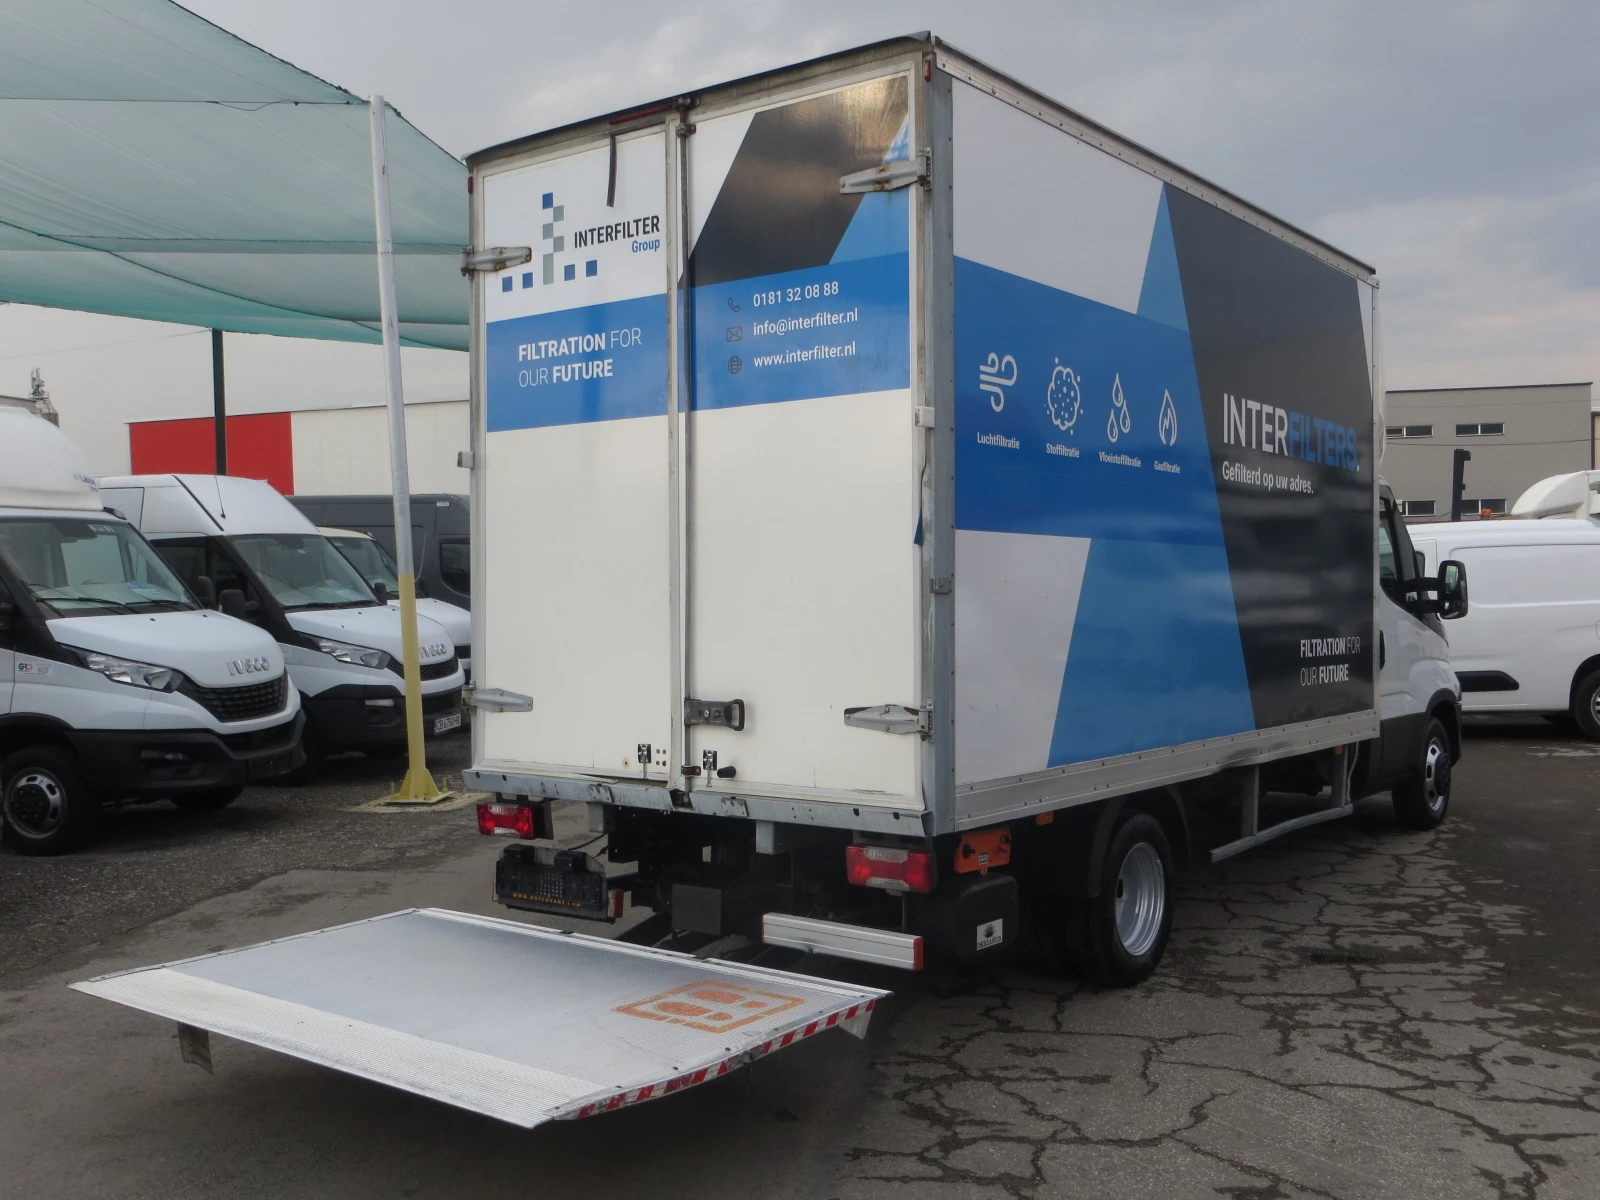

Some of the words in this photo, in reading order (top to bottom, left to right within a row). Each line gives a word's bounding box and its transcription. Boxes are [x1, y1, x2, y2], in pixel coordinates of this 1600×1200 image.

[574, 215, 660, 249] INTERFILTER
[631, 239, 661, 253] Group
[753, 291, 782, 307] 0181
[786, 287, 801, 302] 32
[804, 285, 820, 299] 08
[823, 281, 839, 296] 88
[753, 308, 858, 336] info@interfilter.nl
[518, 332, 606, 362] FILTRATION
[610, 327, 642, 349] FOR
[753, 341, 856, 367] www.interfilter.nl
[518, 367, 549, 388] OUR
[552, 358, 614, 384] FUTURE
[977, 432, 1020, 450] Luchtfiltratie
[1046, 443, 1080, 458] Stoffiltratie
[1099, 451, 1141, 468] Vloeistoffiltratie
[1222, 460, 1261, 485] Gefilterd
[1262, 473, 1274, 491] op
[1275, 475, 1288, 489] uw
[1289, 475, 1314, 494] adres.
[1300, 638, 1346, 657] FILTRATION
[1347, 637, 1360, 654] FOR
[226, 656, 270, 676] IVECO
[1300, 666, 1318, 686] OUR
[1319, 663, 1349, 684] FUTURE
